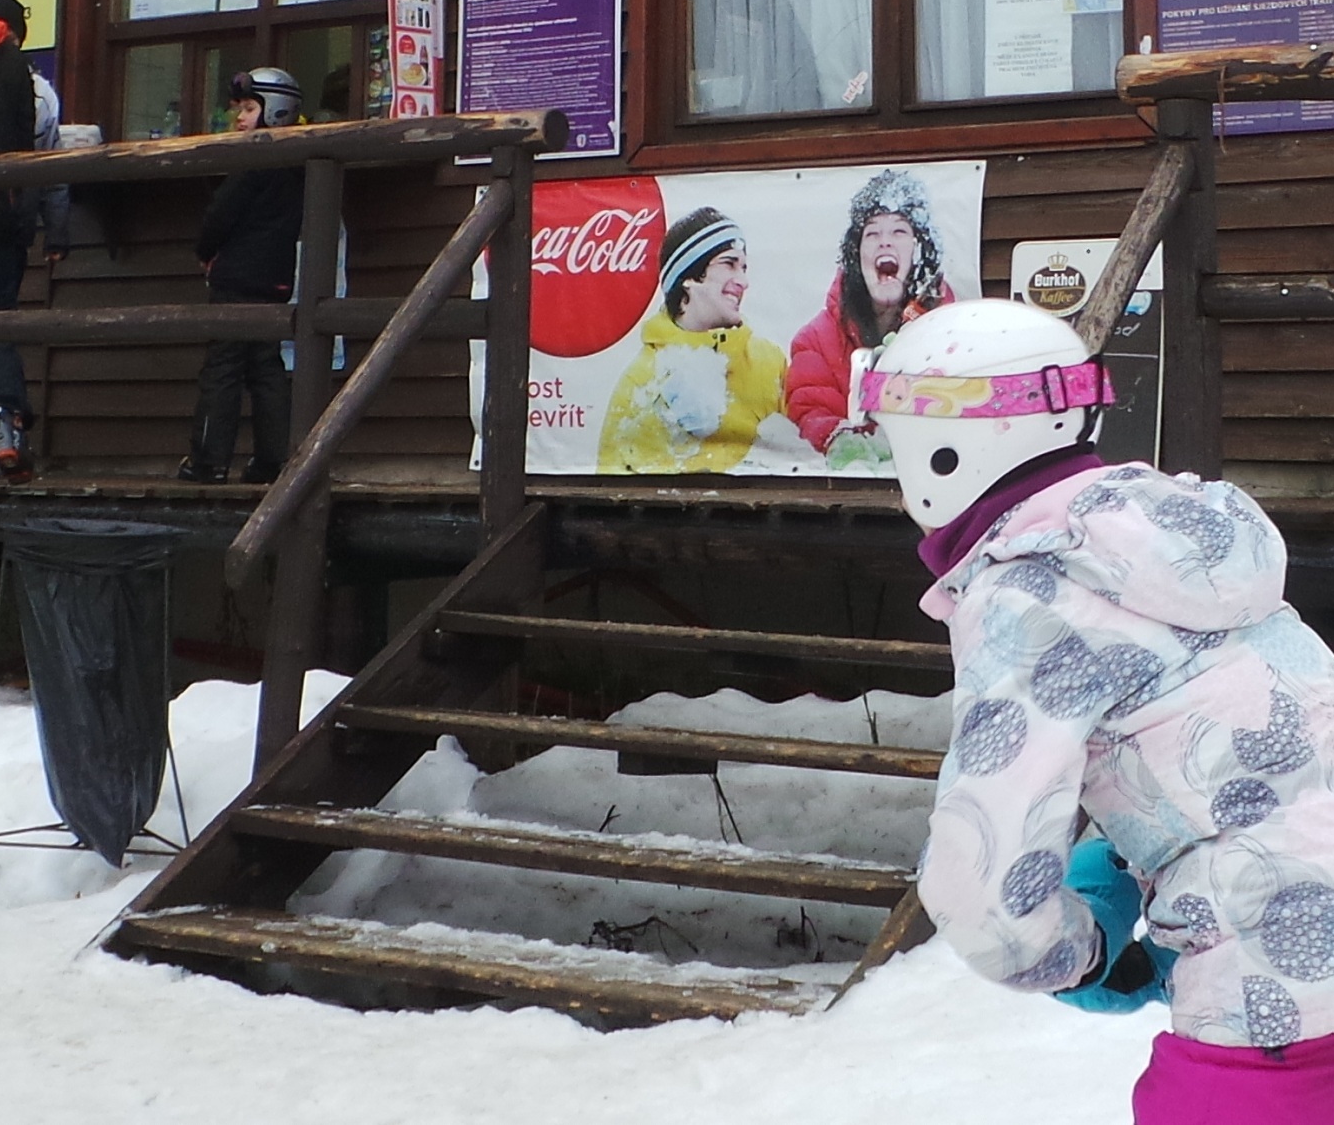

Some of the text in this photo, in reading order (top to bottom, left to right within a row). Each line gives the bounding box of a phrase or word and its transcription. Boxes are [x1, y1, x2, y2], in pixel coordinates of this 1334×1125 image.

[1198, 7, 1216, 16] PRO
[531, 208, 660, 274] ca-Cola
[1034, 272, 1080, 287] Burkhof
[1040, 290, 1073, 304] Kaffee
[527, 377, 563, 398] ost
[529, 404, 585, 428] evřít
